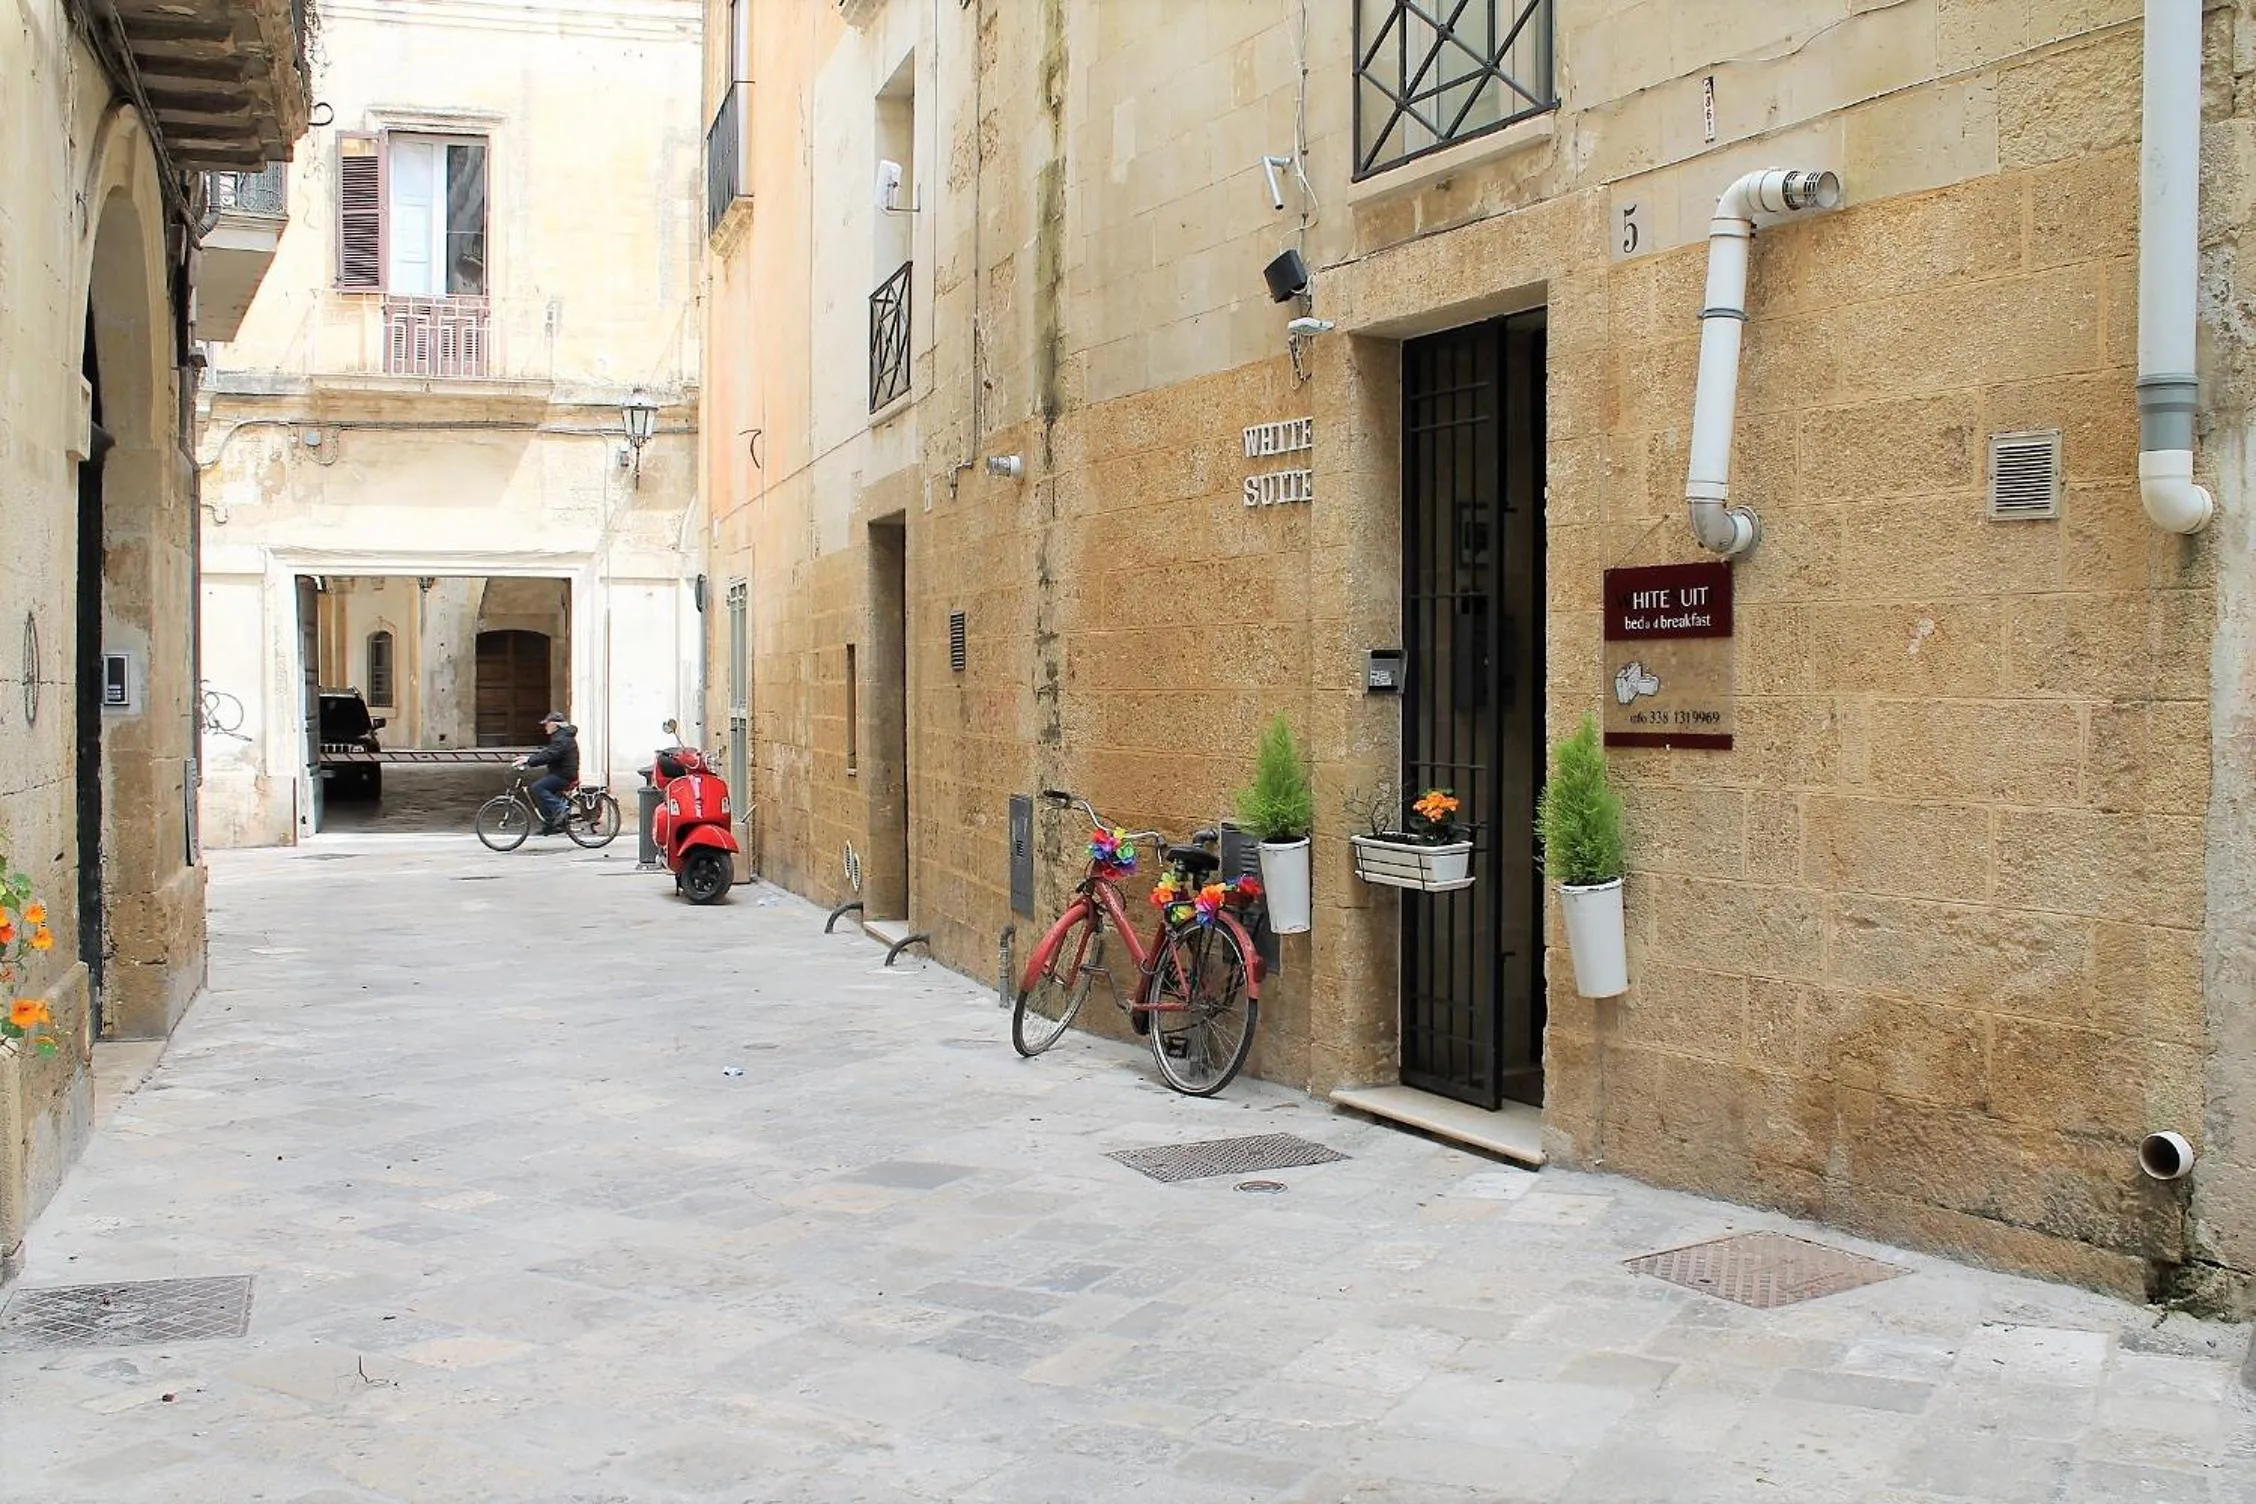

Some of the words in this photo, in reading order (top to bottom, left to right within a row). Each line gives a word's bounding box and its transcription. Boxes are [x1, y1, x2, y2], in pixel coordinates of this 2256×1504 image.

[1623, 204, 1638, 253] 5
[1243, 416, 1313, 457] WHITE
[1243, 469, 1313, 506] SUITE
[1660, 612, 1711, 629] breakfast
[1649, 711, 1669, 724] 338
[1674, 711, 1721, 724] 1319969
